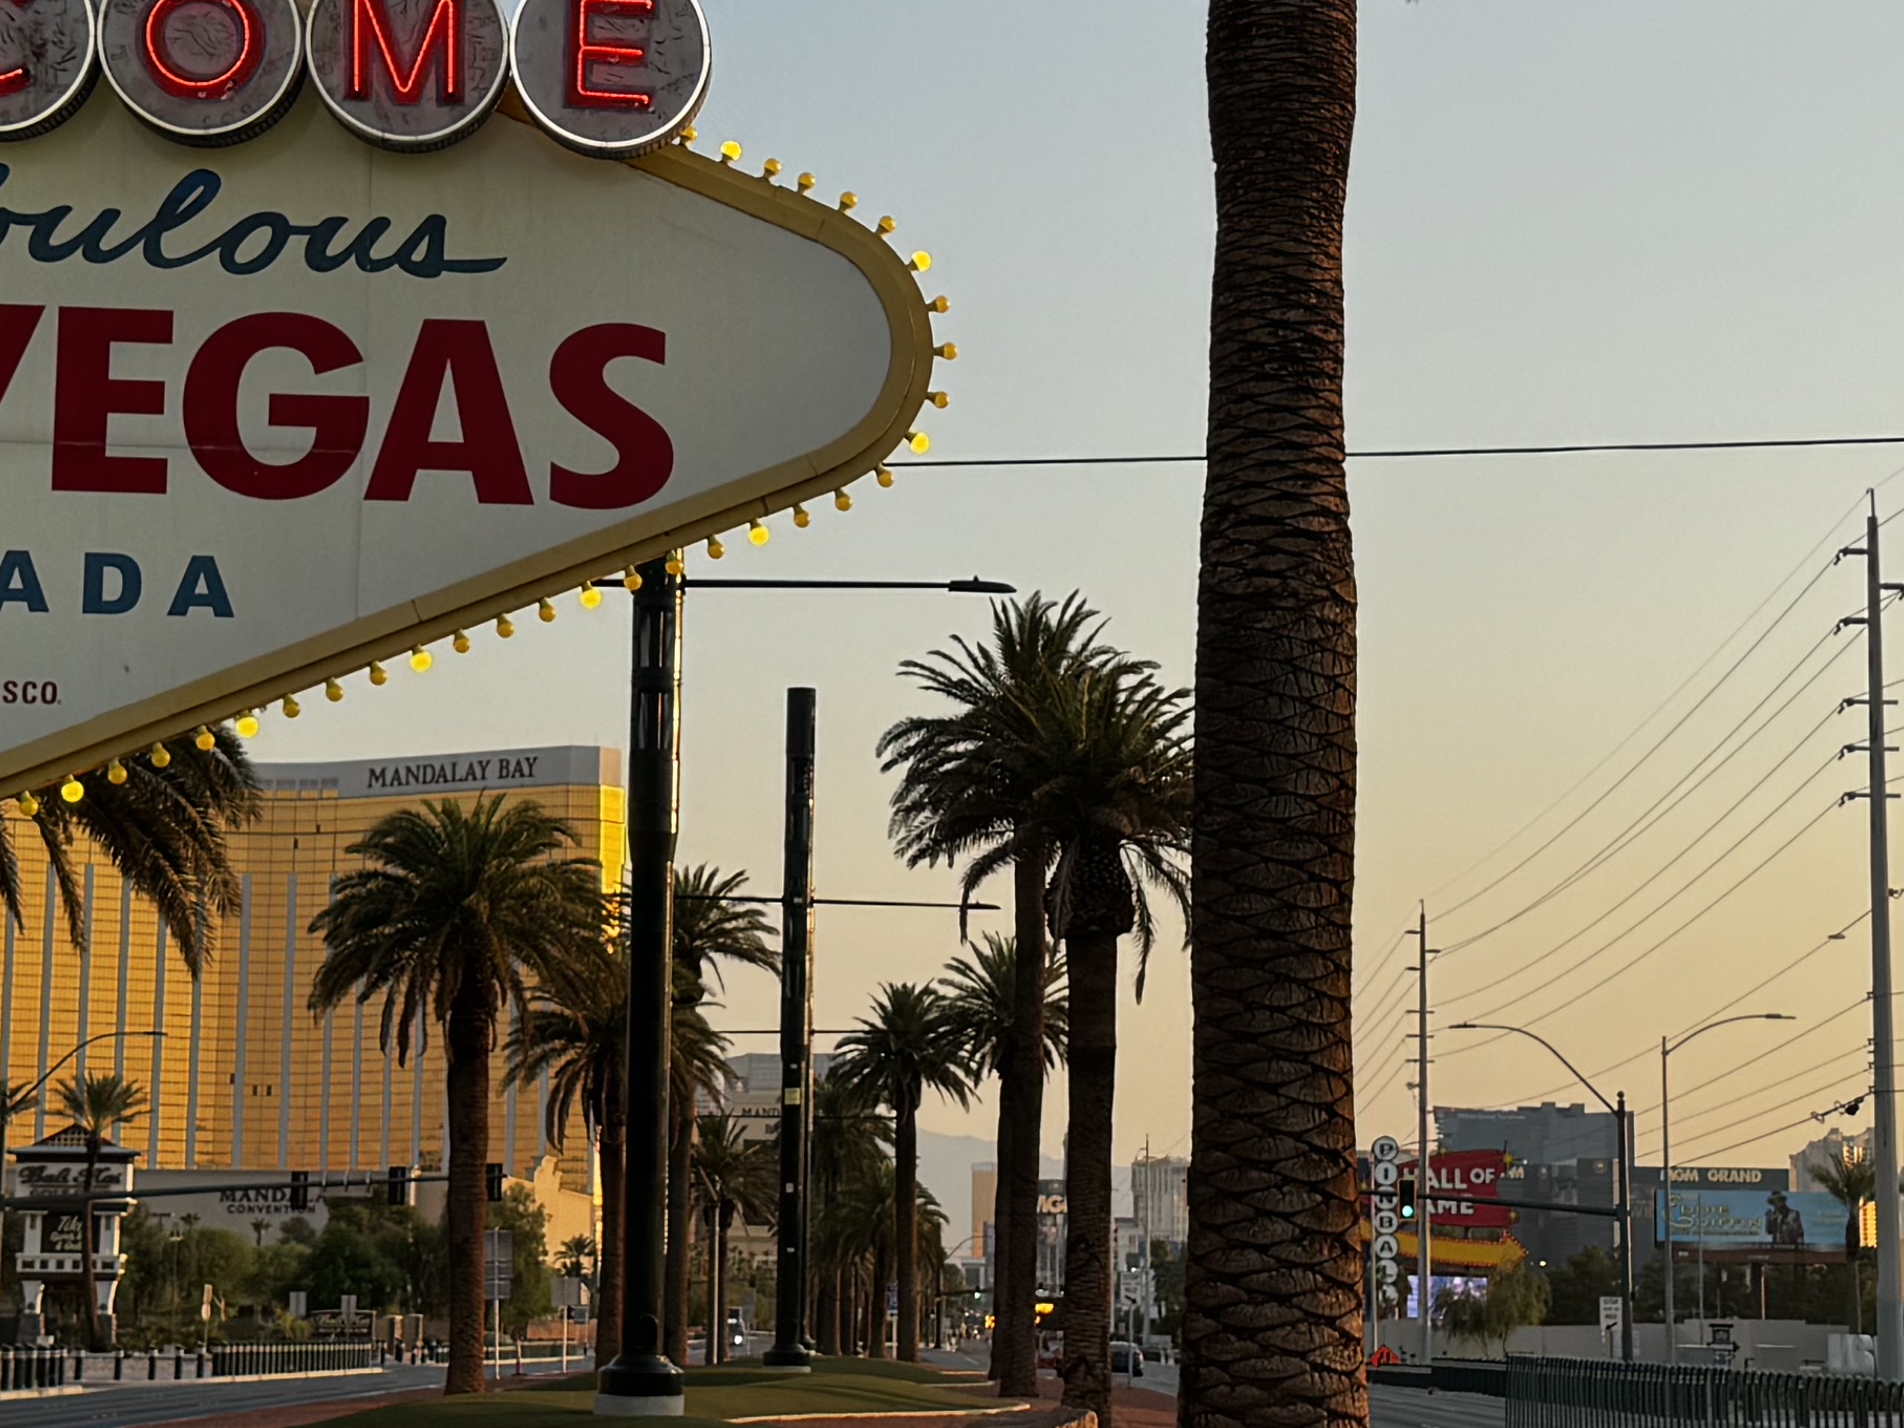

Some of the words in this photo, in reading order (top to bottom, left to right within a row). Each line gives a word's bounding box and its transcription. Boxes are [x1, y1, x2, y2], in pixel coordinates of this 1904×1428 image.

[367, 759, 492, 788] MANDALAY
[498, 756, 538, 780] BAY
[1470, 1168, 1495, 1184] OF
[1707, 1169, 1762, 1183] GRAND
[226, 1204, 316, 1215] CONVENTN
